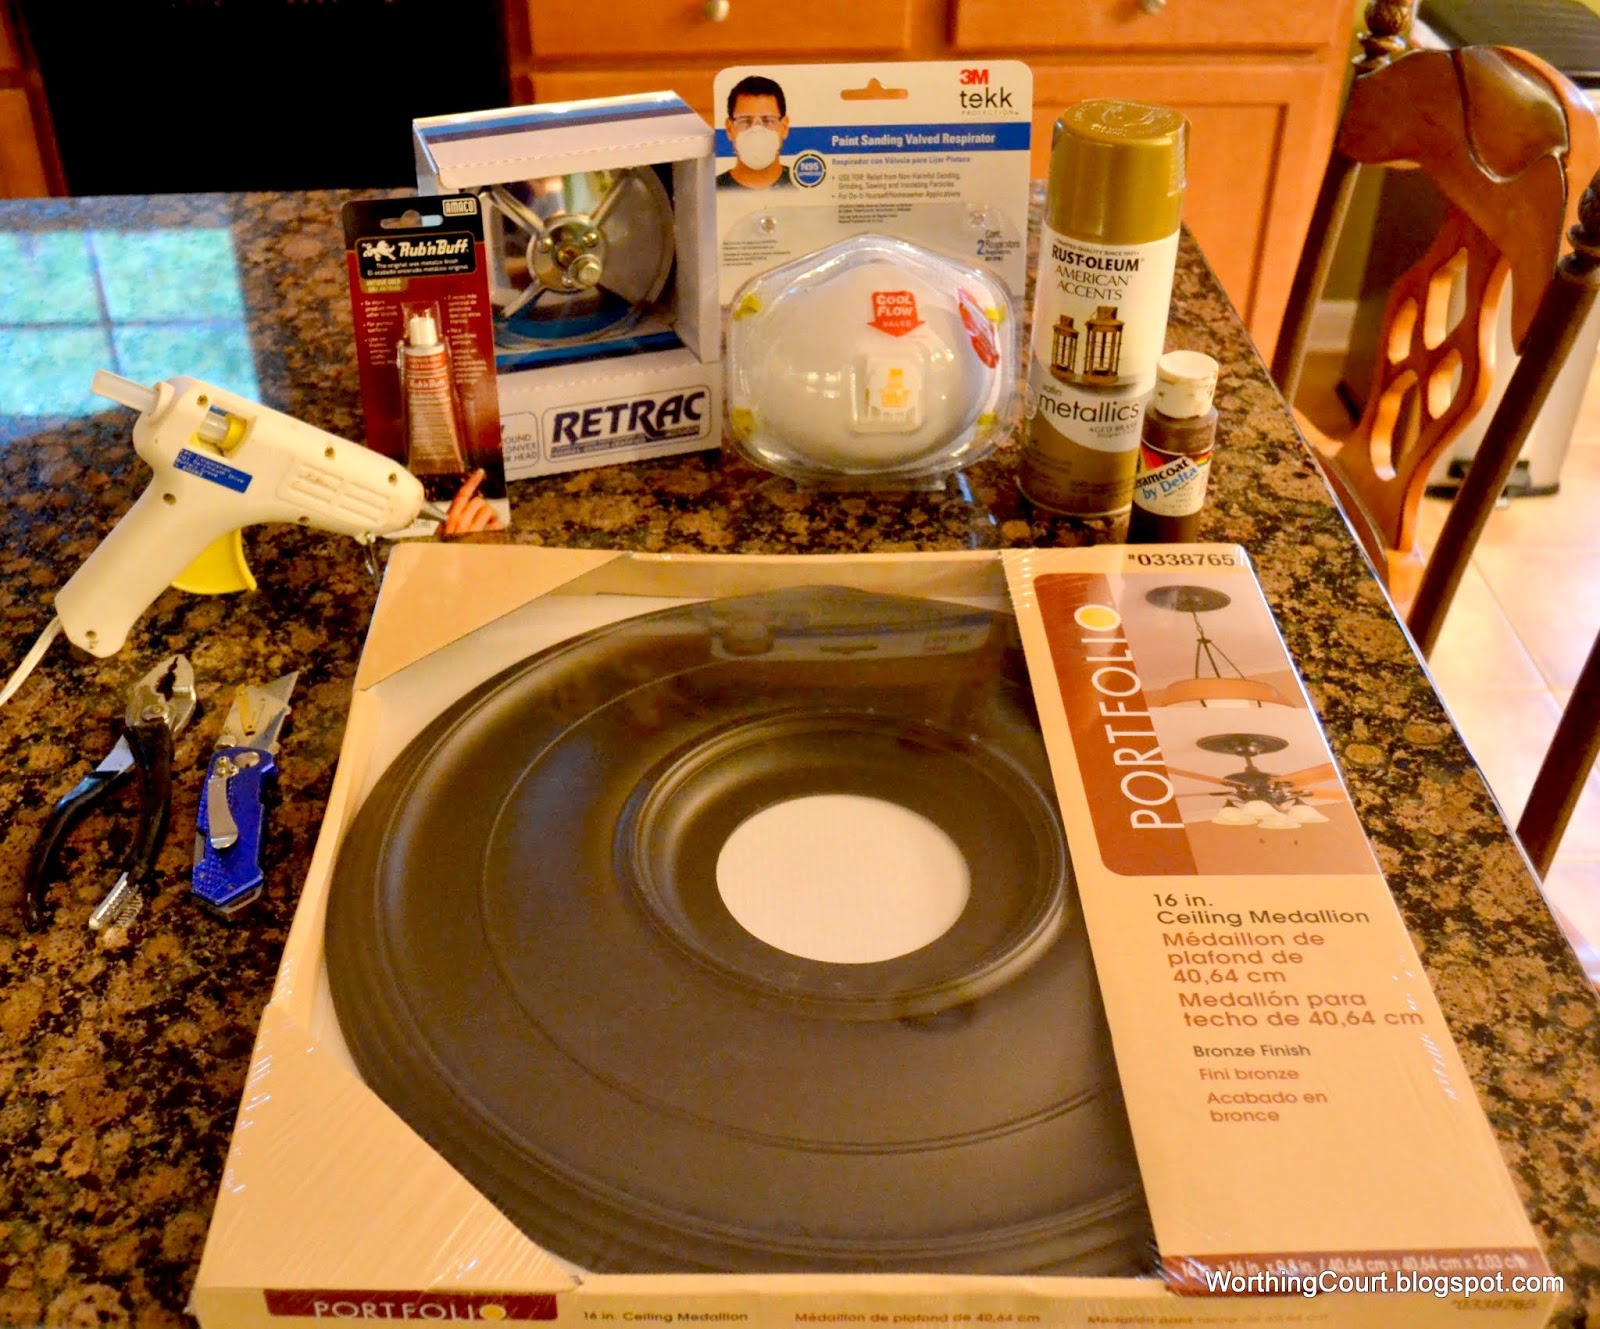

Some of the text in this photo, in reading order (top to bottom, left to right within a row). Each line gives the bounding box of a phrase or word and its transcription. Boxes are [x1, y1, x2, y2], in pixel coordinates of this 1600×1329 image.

[960, 68, 988, 85] 3M
[960, 87, 1012, 108] tekk
[832, 132, 996, 147] Paint Sanding Valved Respirator
[445, 200, 474, 213] AMACO
[1052, 244, 1140, 272] RUST-OLEUM
[1055, 265, 1129, 287] AMERICAN
[1057, 280, 1123, 300] ACCENTS
[876, 294, 912, 305] COOL
[877, 306, 913, 317] FLOW
[1039, 394, 1139, 422] metallics
[552, 391, 705, 445] RETRAC
[504, 434, 531, 444] OUND
[505, 443, 536, 453] ONVEX
[1159, 467, 1198, 493] Delta
[1074, 604, 1185, 829] PORTFOLIO
[1153, 893, 1214, 908] 16 in.
[1156, 909, 1371, 928] Ceiling Medallion
[1162, 931, 1326, 948] Médaillon de
[1167, 949, 1304, 968] plafond de
[1173, 968, 1287, 986] 40,64 cm
[1178, 990, 1367, 1009] Medallón para
[1184, 1010, 1425, 1028] techo de 40,64 cm
[1193, 1044, 1312, 1058] Bronze Finish
[1199, 1067, 1299, 1081] Fini bronze
[1207, 1091, 1328, 1105] Acabado en
[1210, 1109, 1280, 1123] bronce
[314, 1301, 506, 1320] PORTFOLIO
[584, 1311, 597, 1321] 16
[623, 1311, 673, 1322] Ceiling
[677, 1311, 748, 1322] Medallion
[795, 1312, 865, 1323] Médaillon
[870, 1313, 888, 1322] de
[893, 1312, 949, 1324] plafond
[953, 1312, 971, 1322] de
[1017, 1314, 1041, 1323] cm
